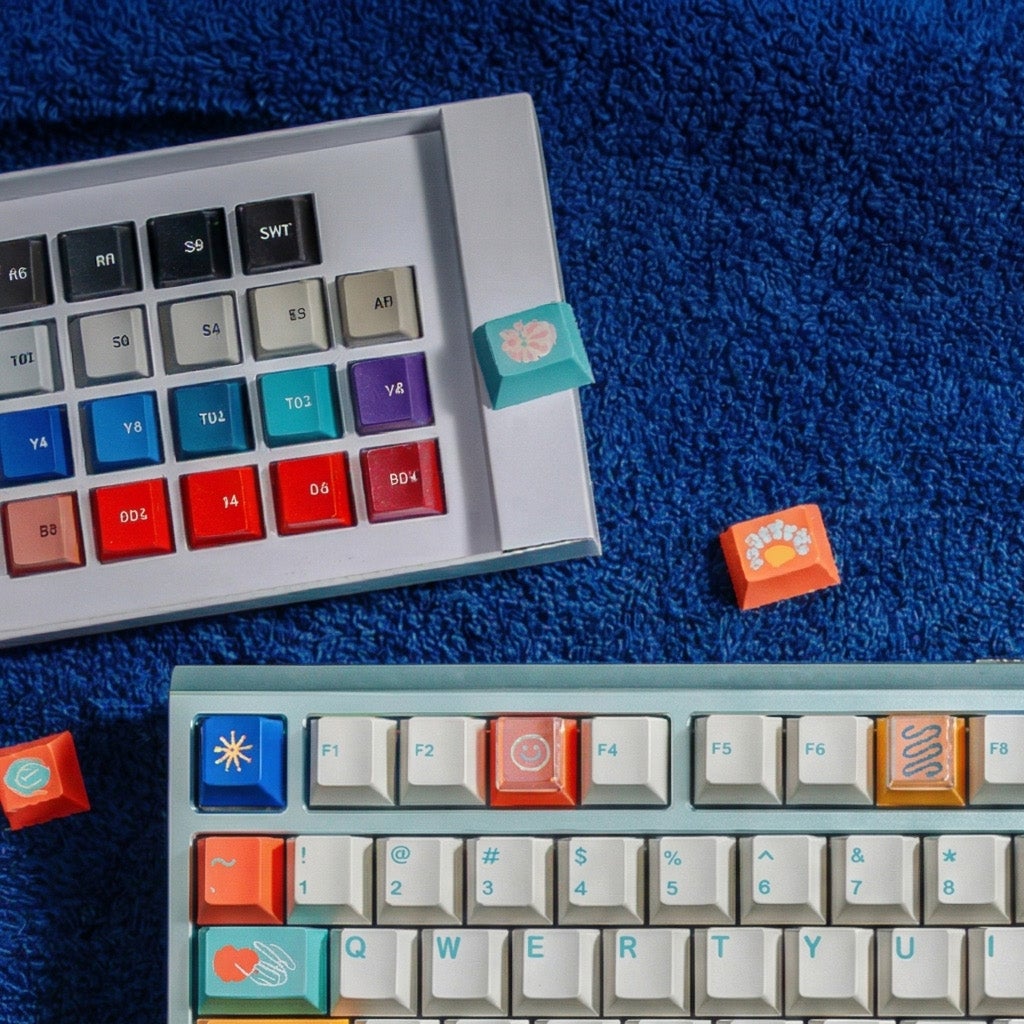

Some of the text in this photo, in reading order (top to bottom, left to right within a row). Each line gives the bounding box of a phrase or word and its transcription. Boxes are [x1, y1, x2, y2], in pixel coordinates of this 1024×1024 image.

[322, 744, 338, 757] F1
[415, 744, 433, 757] F2
[598, 744, 617, 756] F4
[712, 743, 731, 754] F5
[805, 743, 824, 756] F6
[990, 743, 1008, 755] F8
[301, 847, 306, 864] !
[391, 846, 410, 864] @
[482, 848, 499, 864] #
[575, 848, 588, 865] $
[664, 851, 682, 865] %
[758, 850, 774, 860] ^
[851, 848, 864, 863] &
[299, 880, 307, 895] 1
[391, 881, 402, 896] 2
[484, 880, 493, 895] 3
[574, 880, 587, 895] 4
[666, 881, 679, 896] 5
[758, 880, 771, 895] 6
[852, 880, 862, 895] 7
[944, 880, 955, 895] 8
[345, 936, 366, 958] Q
[436, 937, 461, 959] W
[527, 935, 543, 959] E
[619, 935, 637, 958] R
[711, 935, 730, 957] T
[803, 935, 821, 959] Y
[896, 937, 915, 960] U
[987, 935, 994, 956] I
